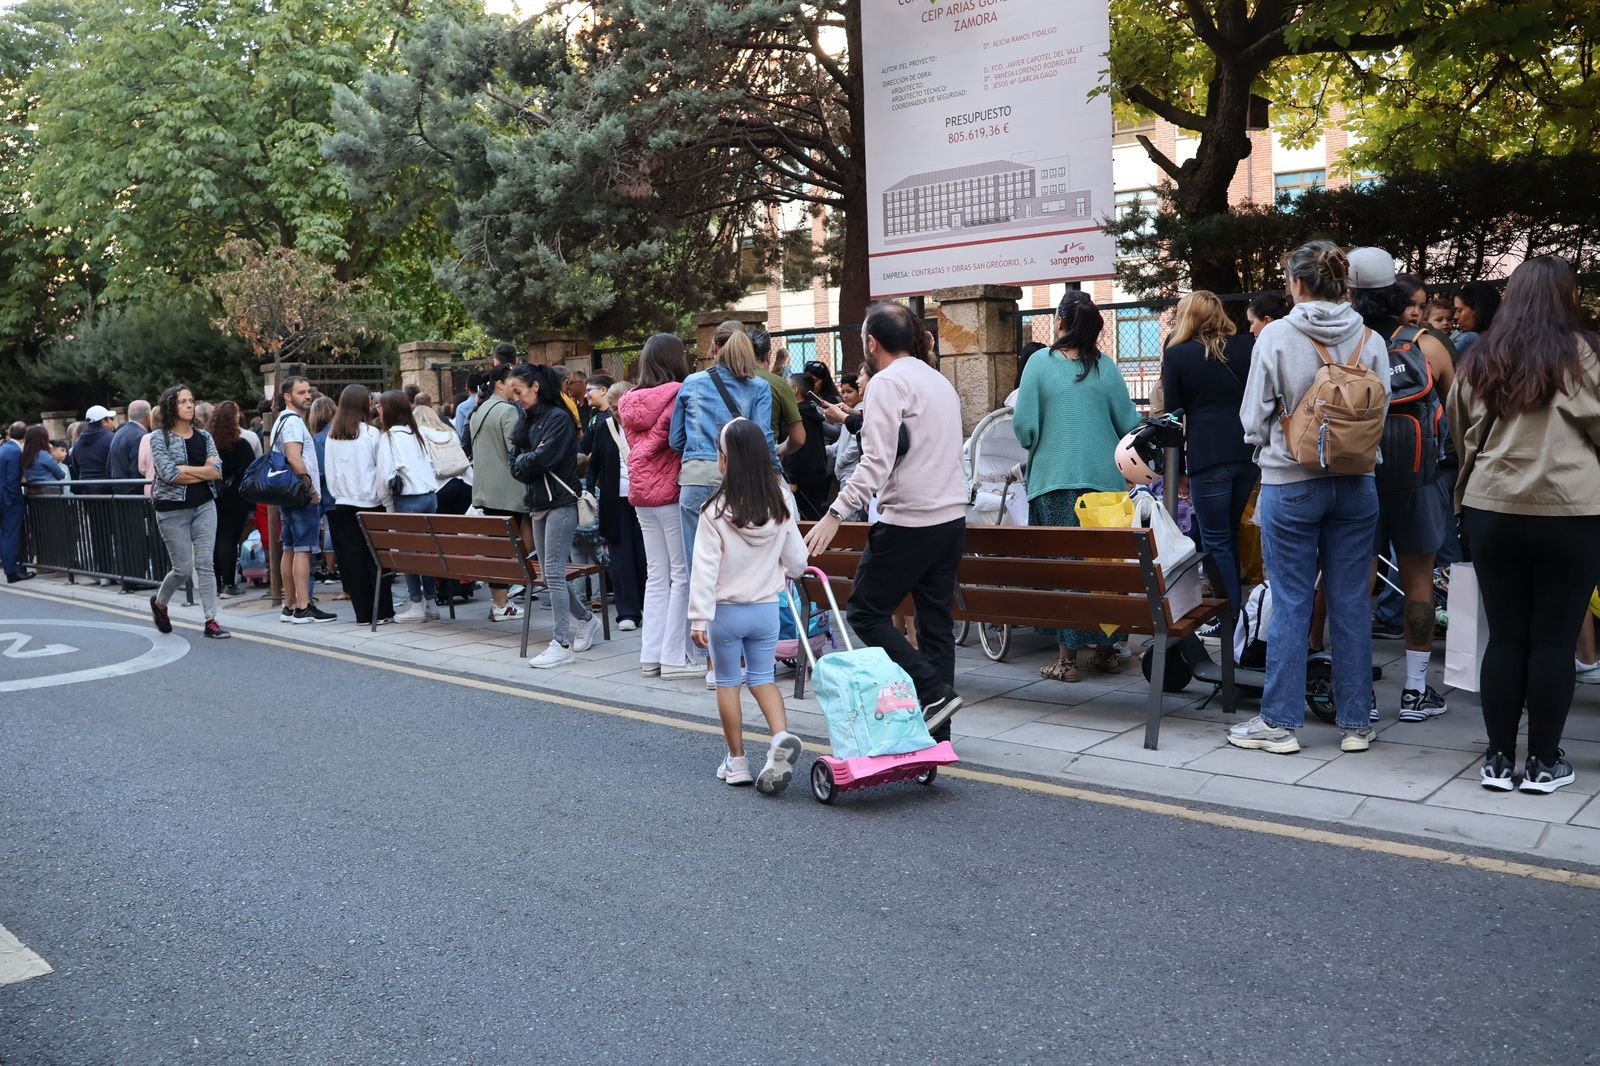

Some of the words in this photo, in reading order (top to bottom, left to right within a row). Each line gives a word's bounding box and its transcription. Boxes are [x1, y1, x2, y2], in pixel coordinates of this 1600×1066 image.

[921, 7, 944, 23] CEIP
[946, 0, 976, 16] ARIAS
[954, 11, 998, 31] ZAMORA
[1032, 26, 1057, 38] FIDALGO
[1053, 50, 1064, 58] DEL
[1065, 45, 1084, 55] VALLE
[881, 64, 898, 74] AUTOR
[898, 62, 908, 71] DEL
[909, 55, 937, 67] PROYECTO:
[994, 70, 1014, 80] VANESA
[1015, 64, 1042, 76] LORENZO
[917, 71, 933, 80] OBRA:
[1040, 69, 1058, 79] GAGO
[891, 97, 928, 111] COORDINADOR
[936, 89, 967, 101] SEGURIDAD:
[892, 91, 923, 103] ARQUITECTO
[945, 105, 1012, 127] PRESUPUESTO
[948, 124, 1000, 143] 805.619,36
[1003, 122, 1010, 134] €
[882, 270, 910, 280] EMPRESA:
[911, 266, 945, 277] CONTRATAS
[946, 265, 951, 273] Y
[951, 264, 972, 273] OBRAS
[1023, 257, 1037, 266] S.A.
[1049, 253, 1095, 267] sangregorio
